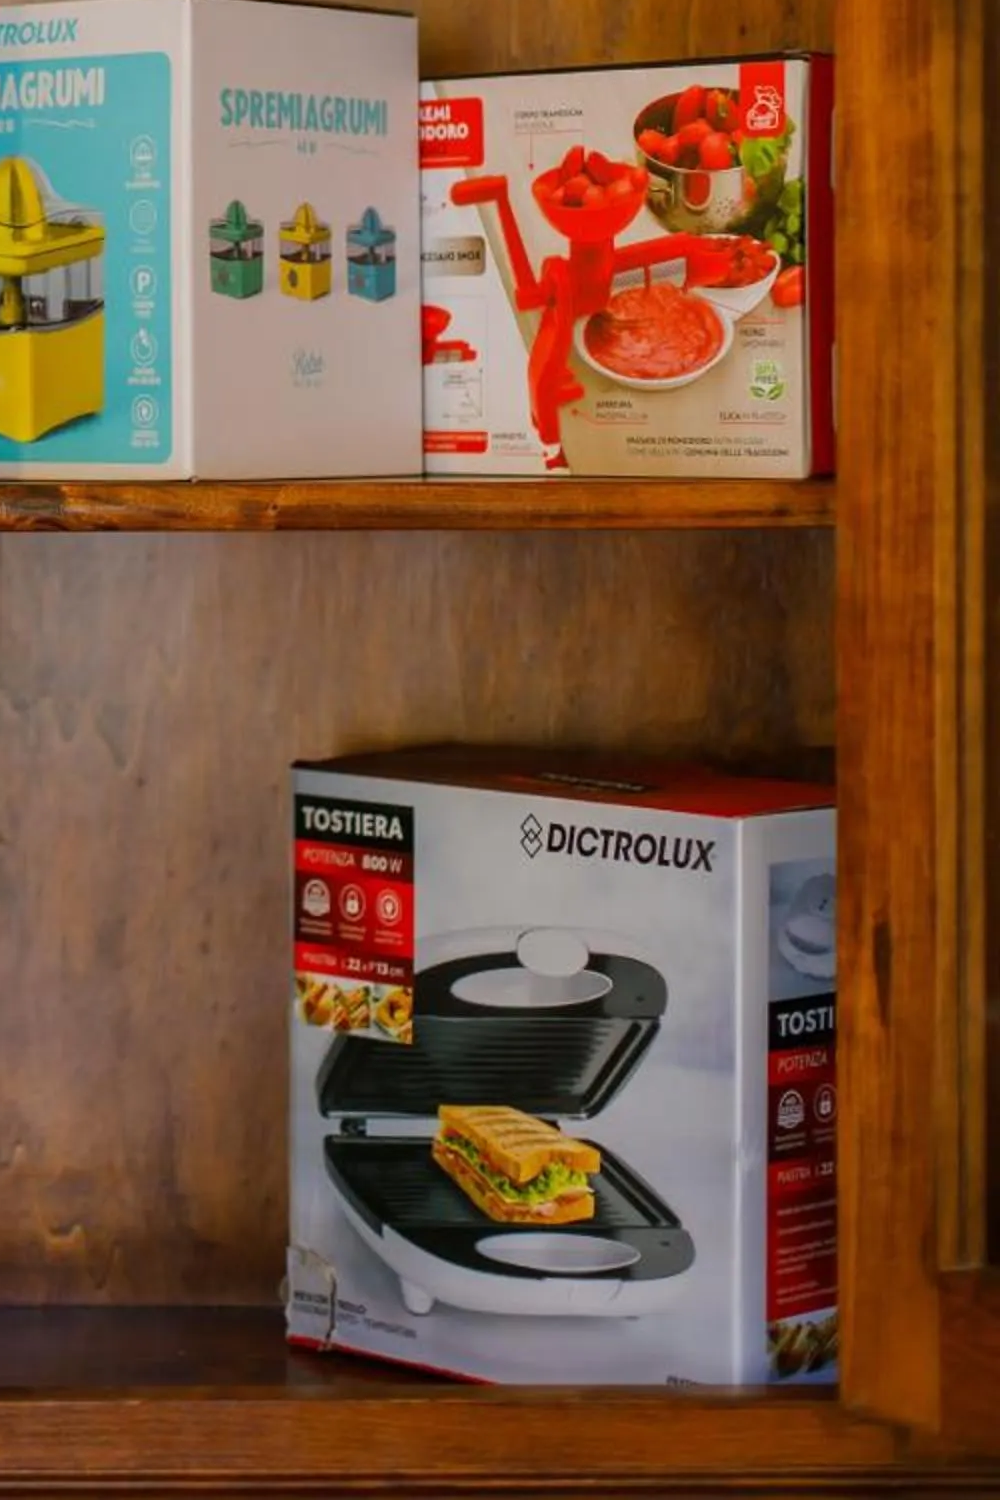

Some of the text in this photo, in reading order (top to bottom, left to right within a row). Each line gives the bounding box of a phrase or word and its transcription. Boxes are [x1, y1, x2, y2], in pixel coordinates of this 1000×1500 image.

[220, 88, 388, 137] SPREMIAGRUMI
[301, 806, 404, 841] TOSTIERA
[302, 848, 403, 874] POTENZA 800 W
[546, 822, 715, 872] DICTROLUX
[777, 1006, 834, 1037] TOSTI
[777, 1051, 828, 1074] POTENZA
